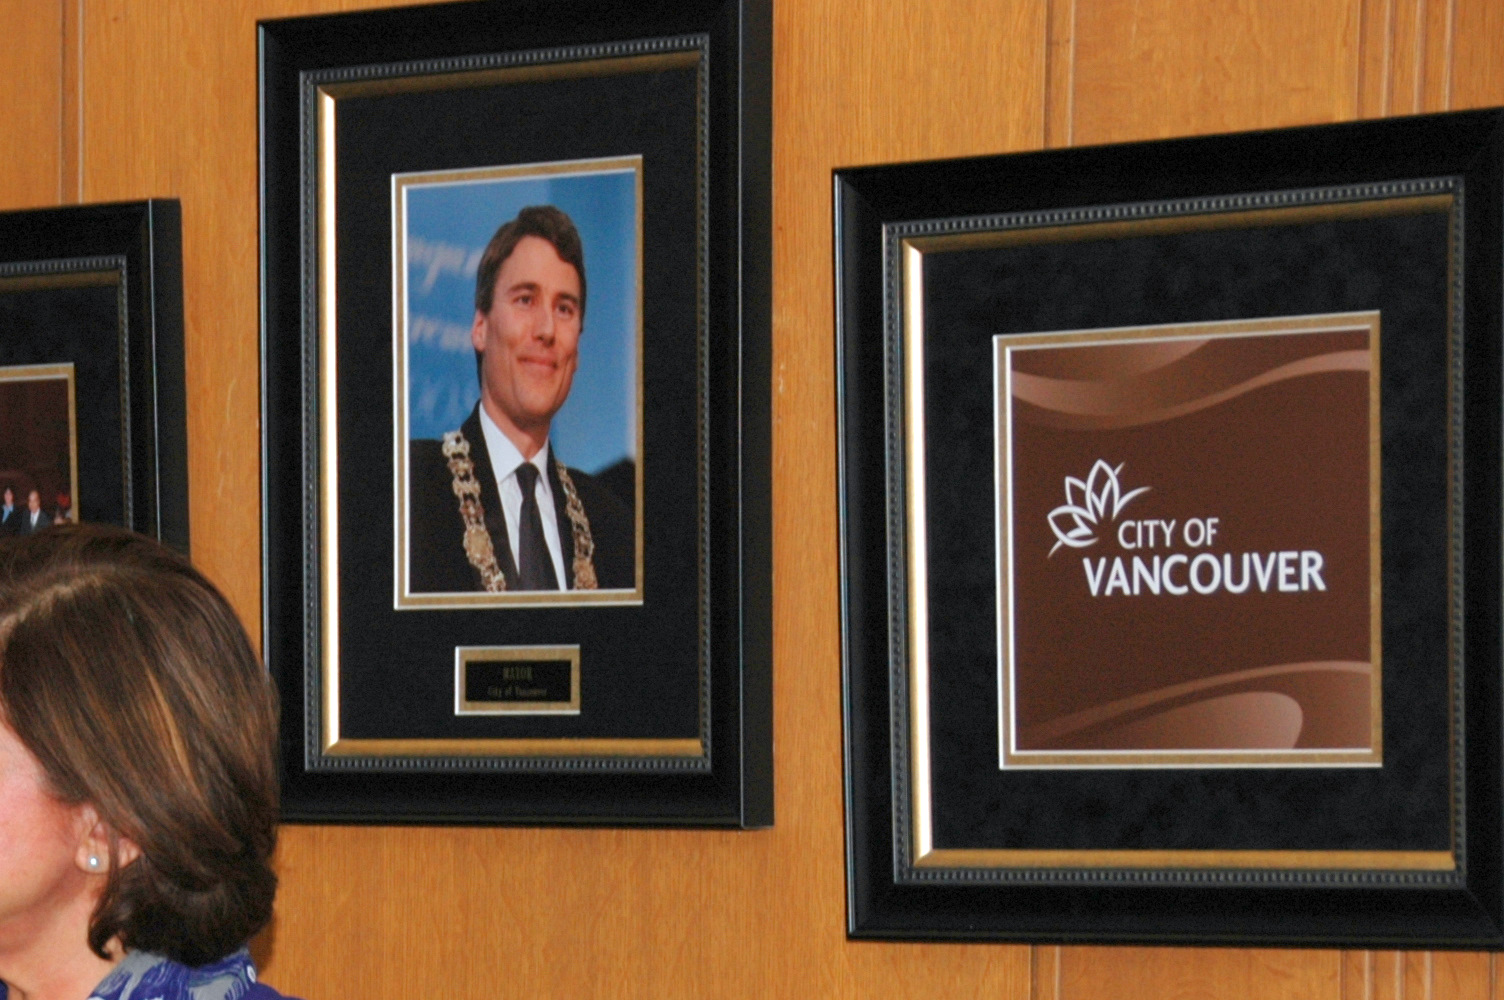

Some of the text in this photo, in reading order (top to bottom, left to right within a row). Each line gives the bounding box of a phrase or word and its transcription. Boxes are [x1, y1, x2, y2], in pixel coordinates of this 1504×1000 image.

[1117, 517, 1220, 550] CITY OF
[1082, 550, 1327, 597] VANCOUVER
